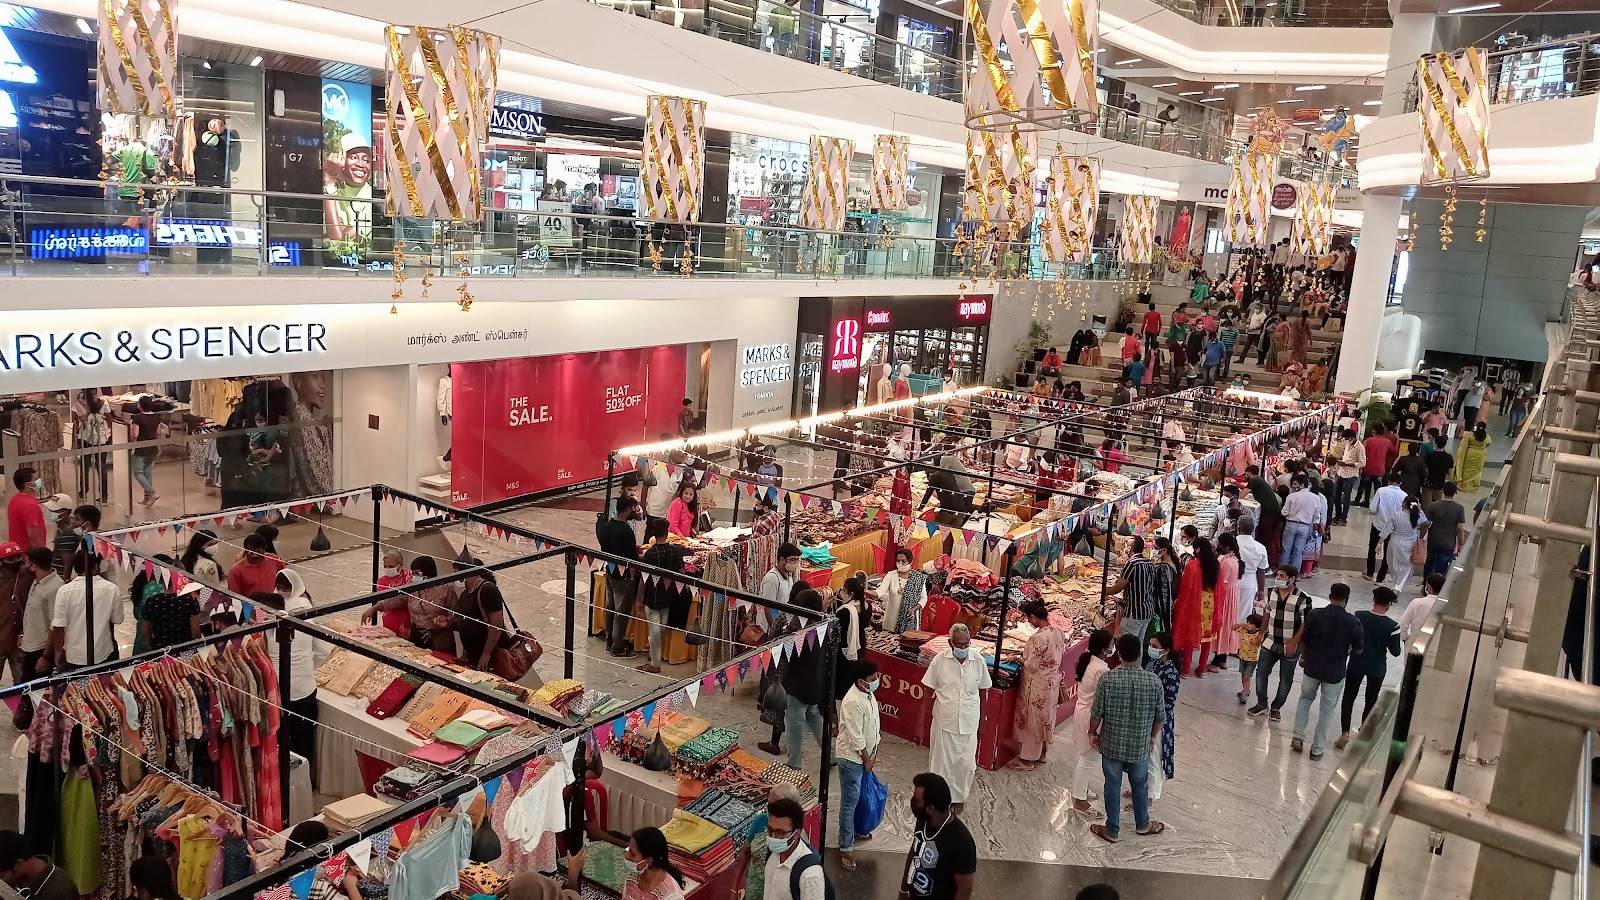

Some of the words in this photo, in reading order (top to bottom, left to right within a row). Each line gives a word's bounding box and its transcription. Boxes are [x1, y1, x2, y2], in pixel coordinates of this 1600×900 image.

[488, 108, 543, 134] MSON
[289, 152, 303, 162] G7
[114, 330, 142, 363] &
[150, 322, 328, 361] SPENCER
[745, 345, 783, 364] MARKS
[783, 344, 791, 360] &
[742, 365, 792, 387] SPENCER
[606, 385, 630, 398] FLAT
[509, 396, 528, 409] THE
[606, 396, 625, 411] 50%
[509, 405, 553, 427] SALE.
[557, 471, 573, 480] SALE.
[506, 481, 520, 491] M&S
[452, 493, 470, 503] SALE.
